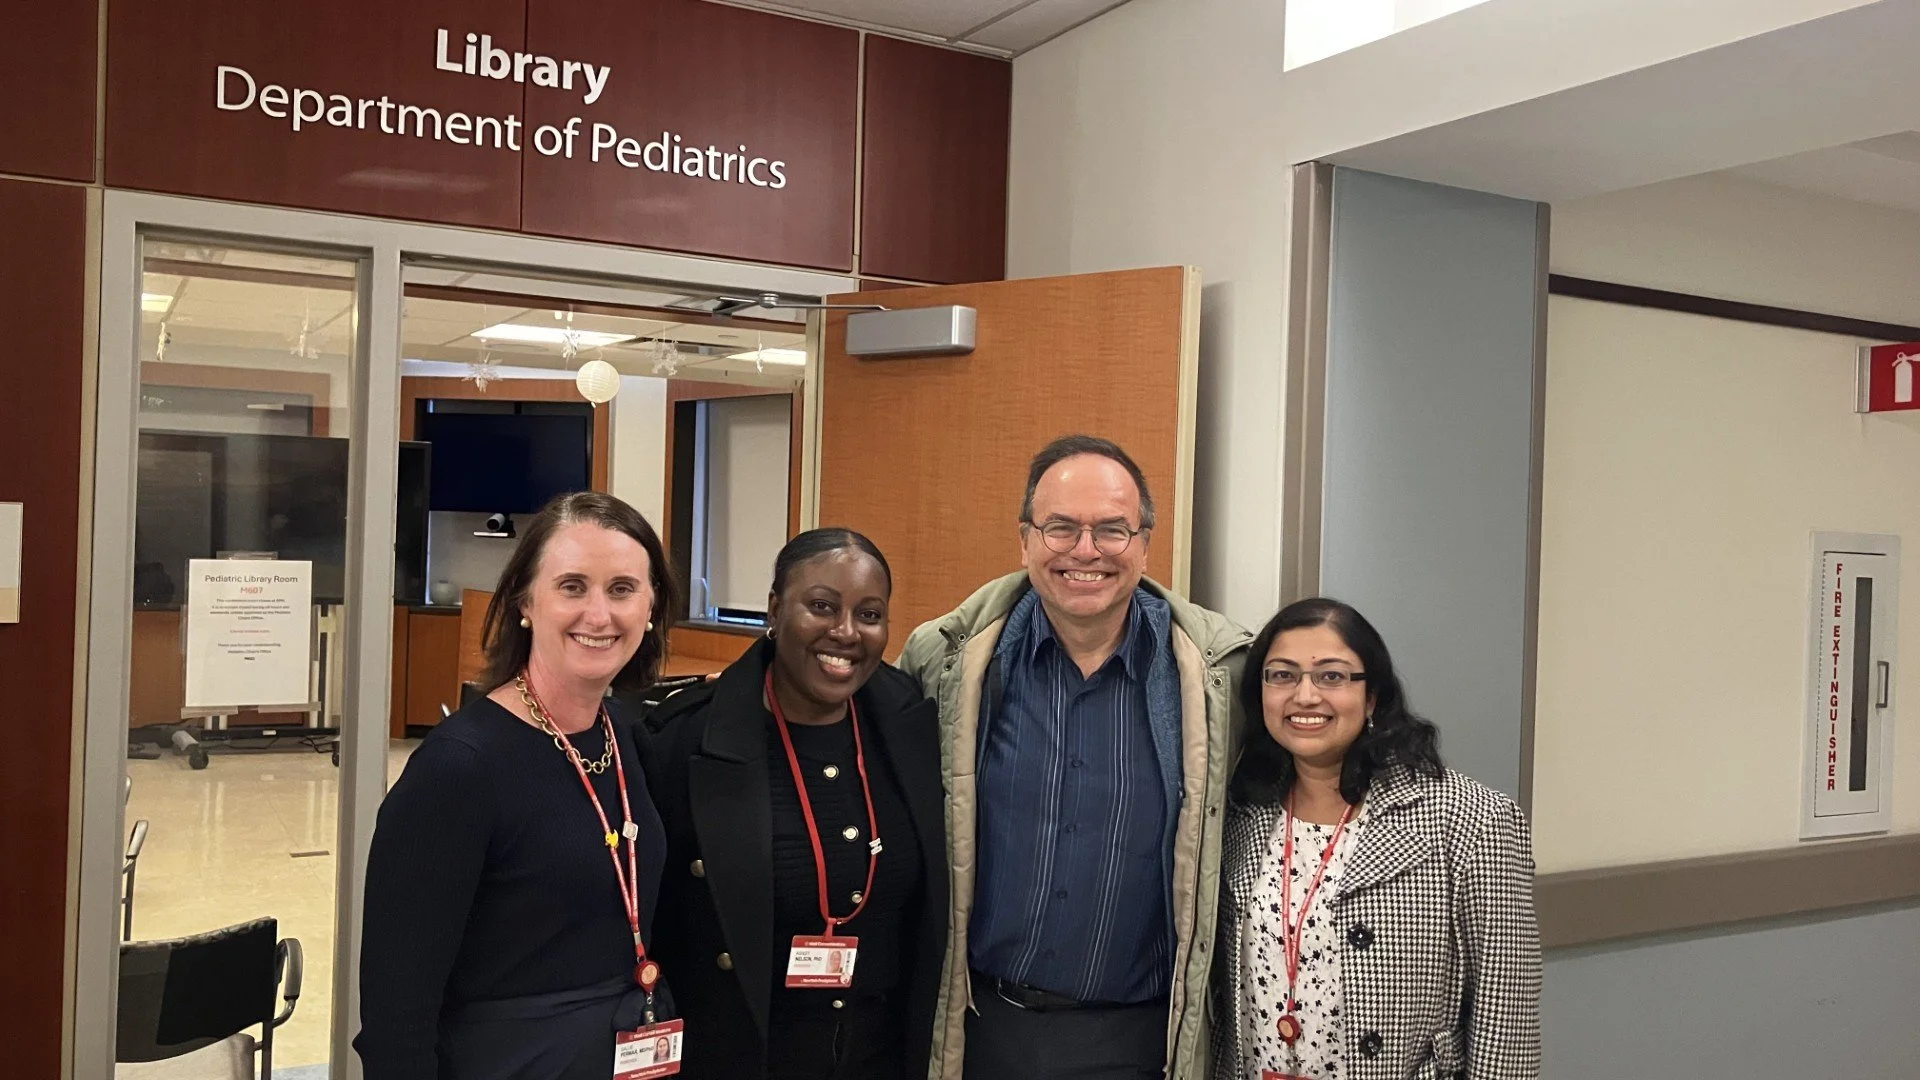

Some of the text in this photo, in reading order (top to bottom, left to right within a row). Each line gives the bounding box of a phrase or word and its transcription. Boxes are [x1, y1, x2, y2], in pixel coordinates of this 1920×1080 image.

[436, 28, 611, 104] Library
[216, 64, 787, 189] Department of Pediatrics
[205, 574, 298, 584] Pediatric Library Room
[1827, 563, 1843, 791] FIRE EXTINGUISHER
